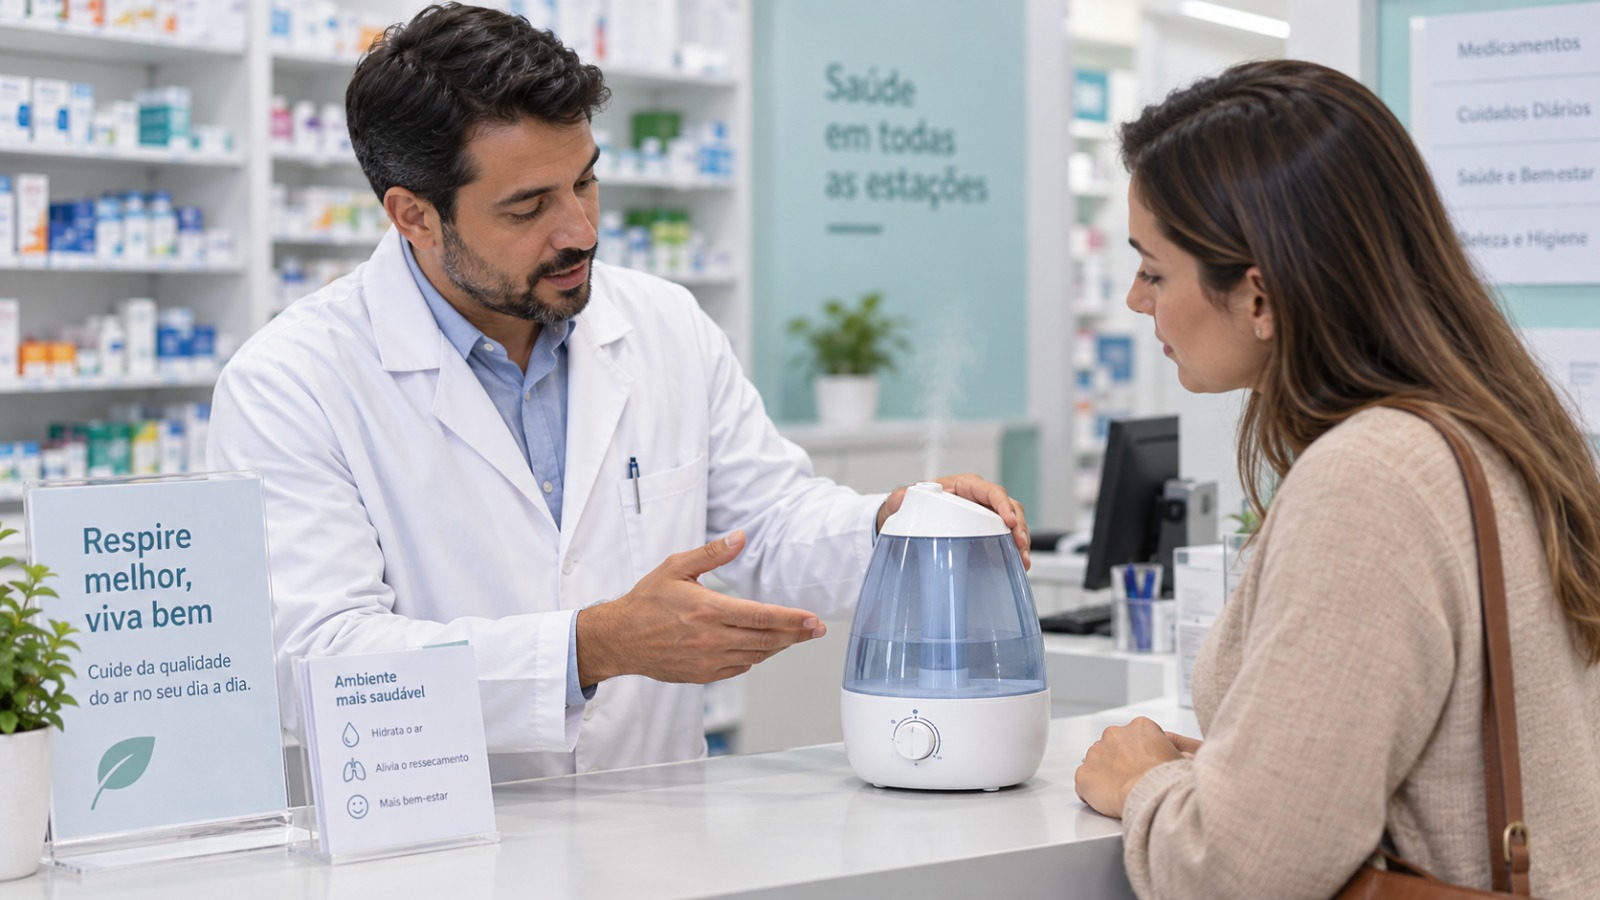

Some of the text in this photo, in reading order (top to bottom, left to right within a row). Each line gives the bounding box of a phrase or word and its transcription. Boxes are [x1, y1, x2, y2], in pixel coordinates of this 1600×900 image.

[1457, 37, 1581, 58] Medicamentos
[825, 62, 917, 108] Saúde
[1456, 100, 1591, 124] Cuidados Diários
[825, 117, 957, 157] em todas
[825, 164, 990, 213] as estações
[1456, 168, 1502, 187] Saúde
[1506, 170, 1517, 184] e
[1513, 234, 1523, 247] e
[1526, 229, 1589, 251] Higiene
[83, 522, 192, 559] Respire
[85, 562, 192, 594] melhor,
[85, 600, 213, 633] viva bem
[87, 653, 231, 680] Cuide da qualidade
[89, 677, 251, 706] do ar no seu dia a dia.
[334, 671, 397, 688] Ambiente
[336, 685, 425, 706] mais saudável
[371, 726, 404, 738] Hidrata
[414, 725, 423, 733] ar
[375, 753, 469, 773] Alivia o ressecamento
[380, 791, 448, 809] Mais bem-estar
